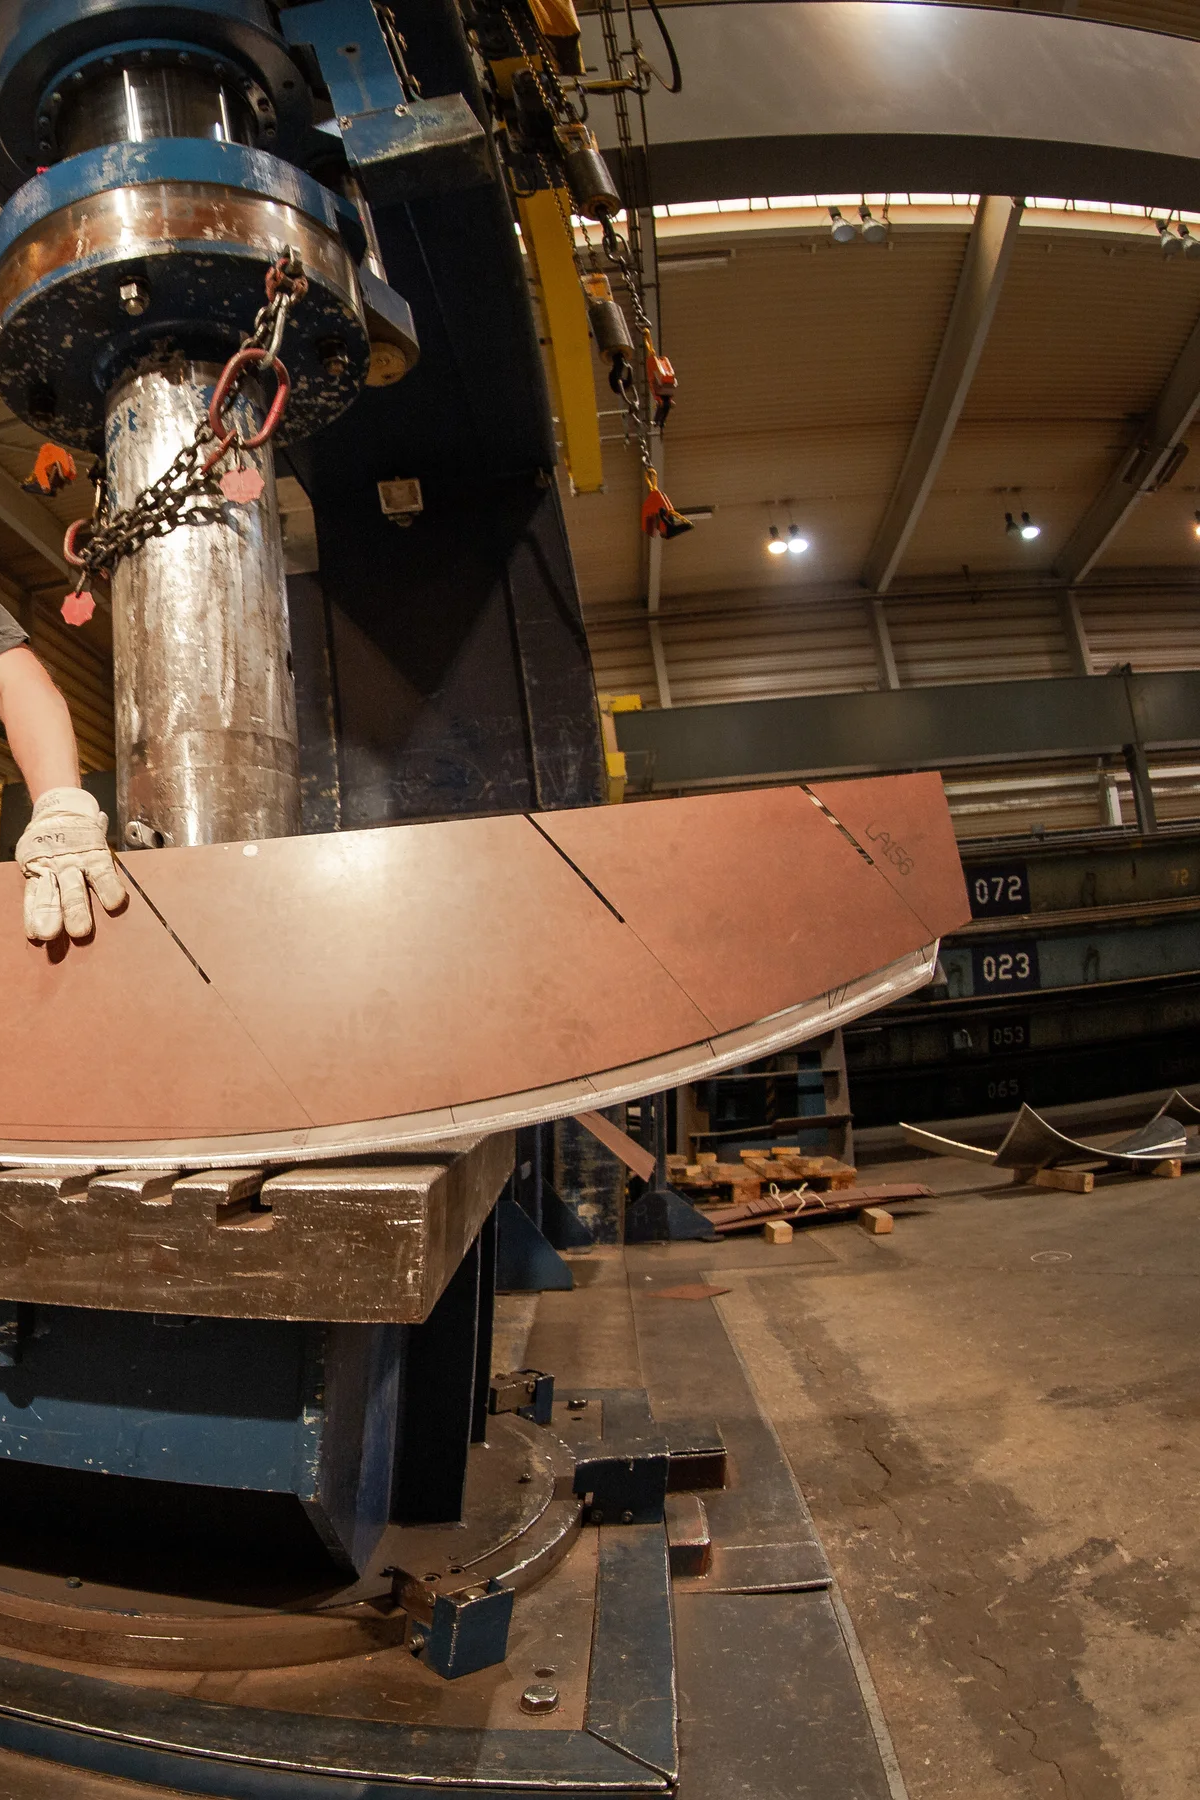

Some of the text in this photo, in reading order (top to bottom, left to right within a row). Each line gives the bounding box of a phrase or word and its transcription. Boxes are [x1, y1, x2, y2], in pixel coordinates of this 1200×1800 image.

[974, 875, 1023, 905] 072
[982, 952, 1031, 982] 023
[992, 1026, 1025, 1045] 053
[987, 1078, 1019, 1099] 065
